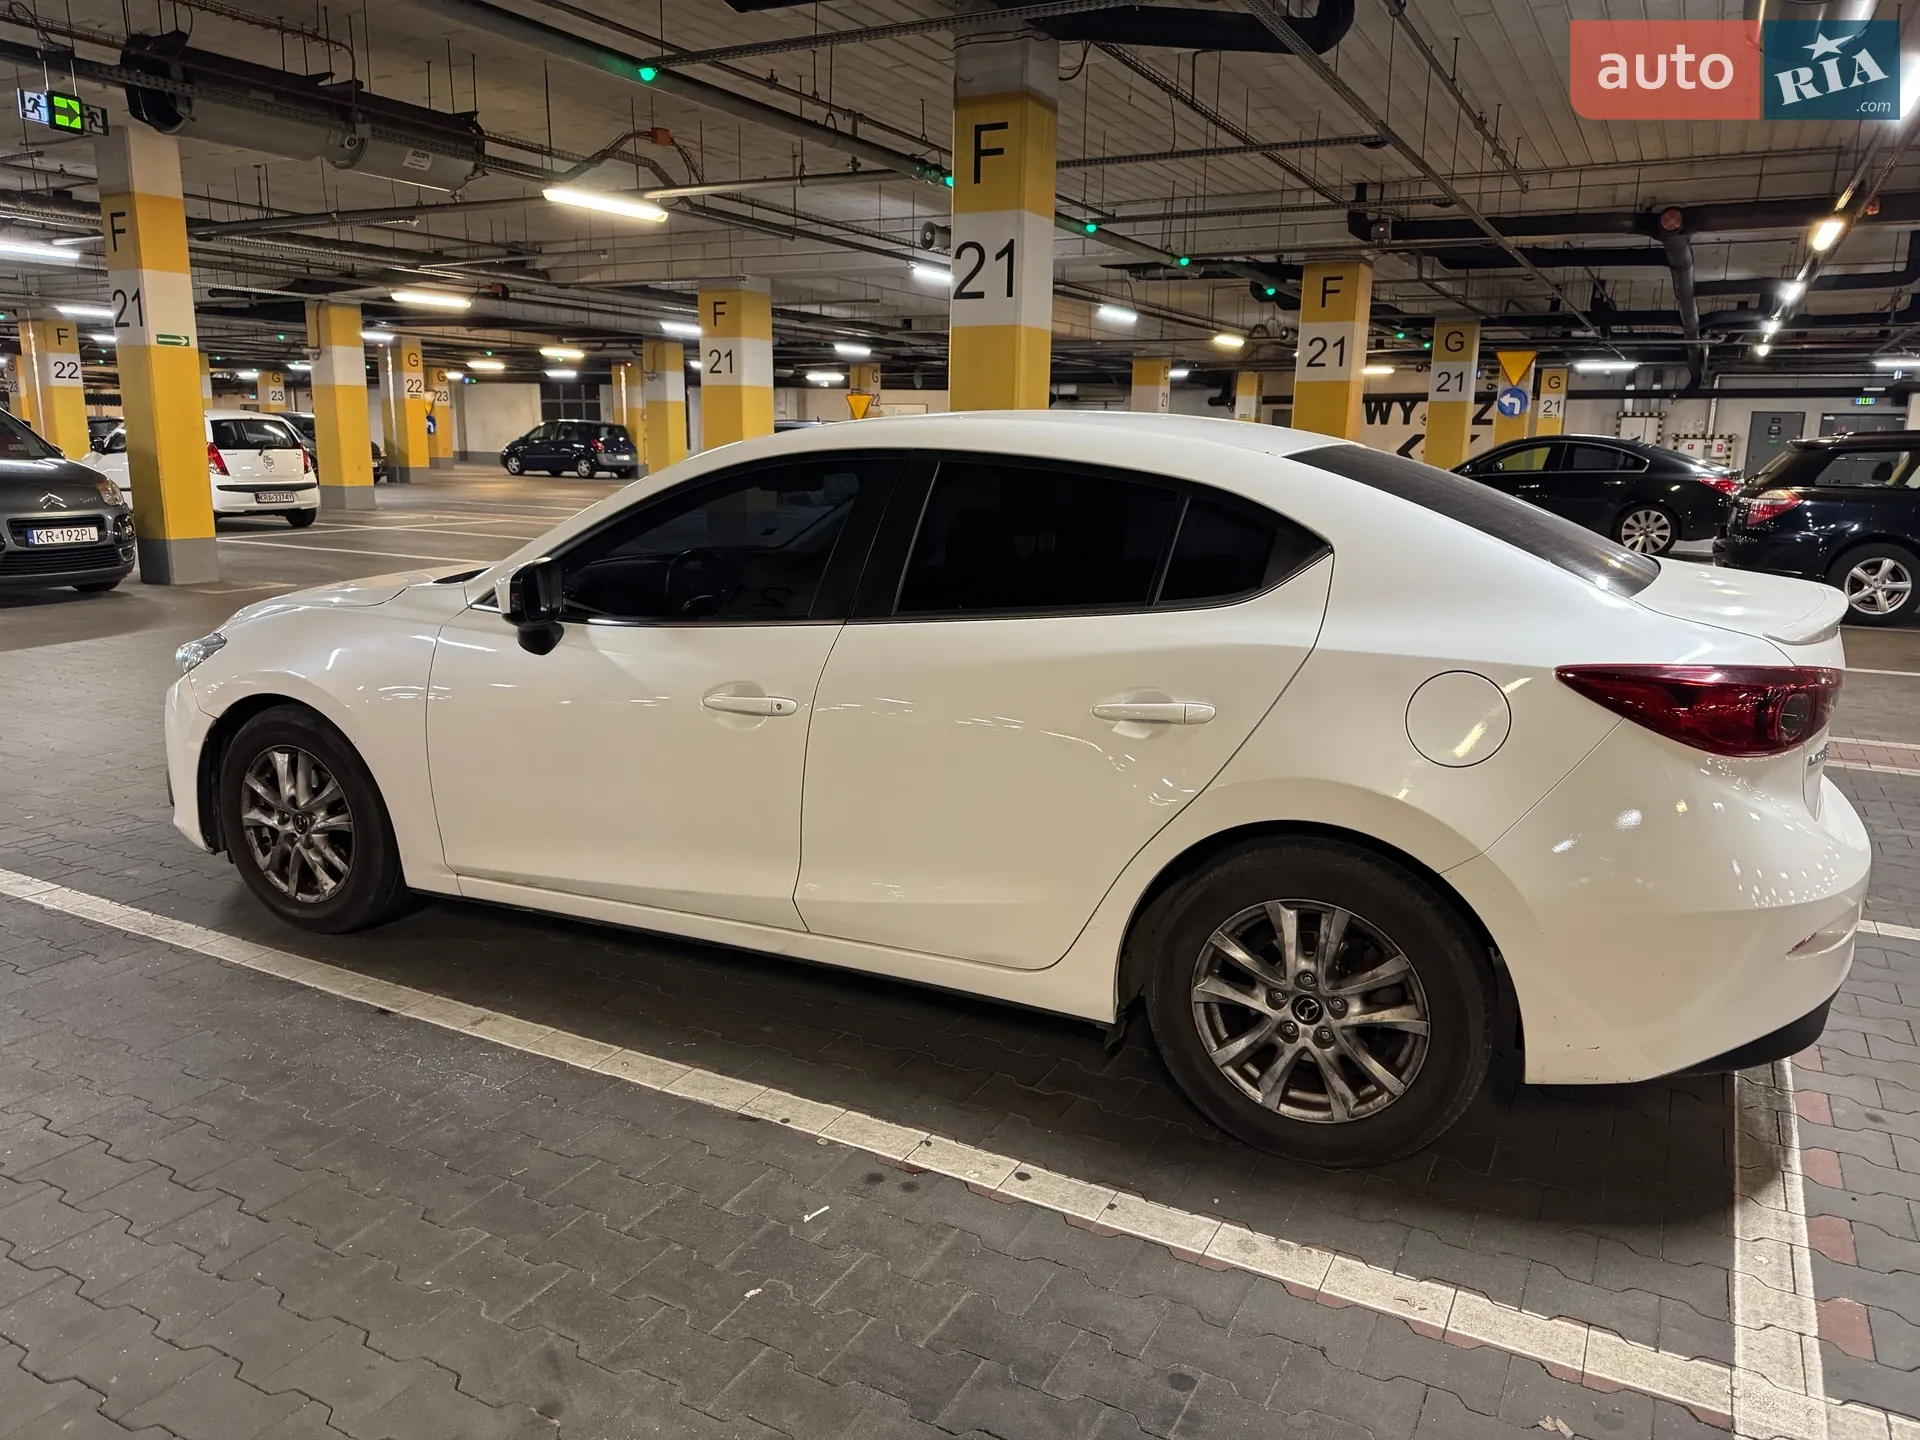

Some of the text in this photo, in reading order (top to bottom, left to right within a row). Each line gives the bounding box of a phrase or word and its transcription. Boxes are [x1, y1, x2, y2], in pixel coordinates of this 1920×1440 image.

[973, 121, 1009, 184] F
[110, 211, 127, 252] F
[953, 238, 1016, 300] 21
[1320, 276, 1344, 308] F
[112, 288, 144, 328] 21
[712, 301, 727, 327] F
[56, 328, 69, 346] F
[1444, 331, 1465, 353] G
[408, 352, 419, 367] G
[1306, 335, 1346, 368] 21
[53, 361, 80, 379] 22
[708, 348, 734, 375] 21
[271, 371, 281, 383] G
[437, 370, 446, 382] G
[872, 369, 879, 383] G
[1435, 370, 1465, 393] 21
[1548, 375, 1561, 389] G
[406, 378, 423, 393] 22
[271, 390, 284, 401] 23
[436, 390, 449, 402] 23
[1543, 400, 1561, 413] 21
